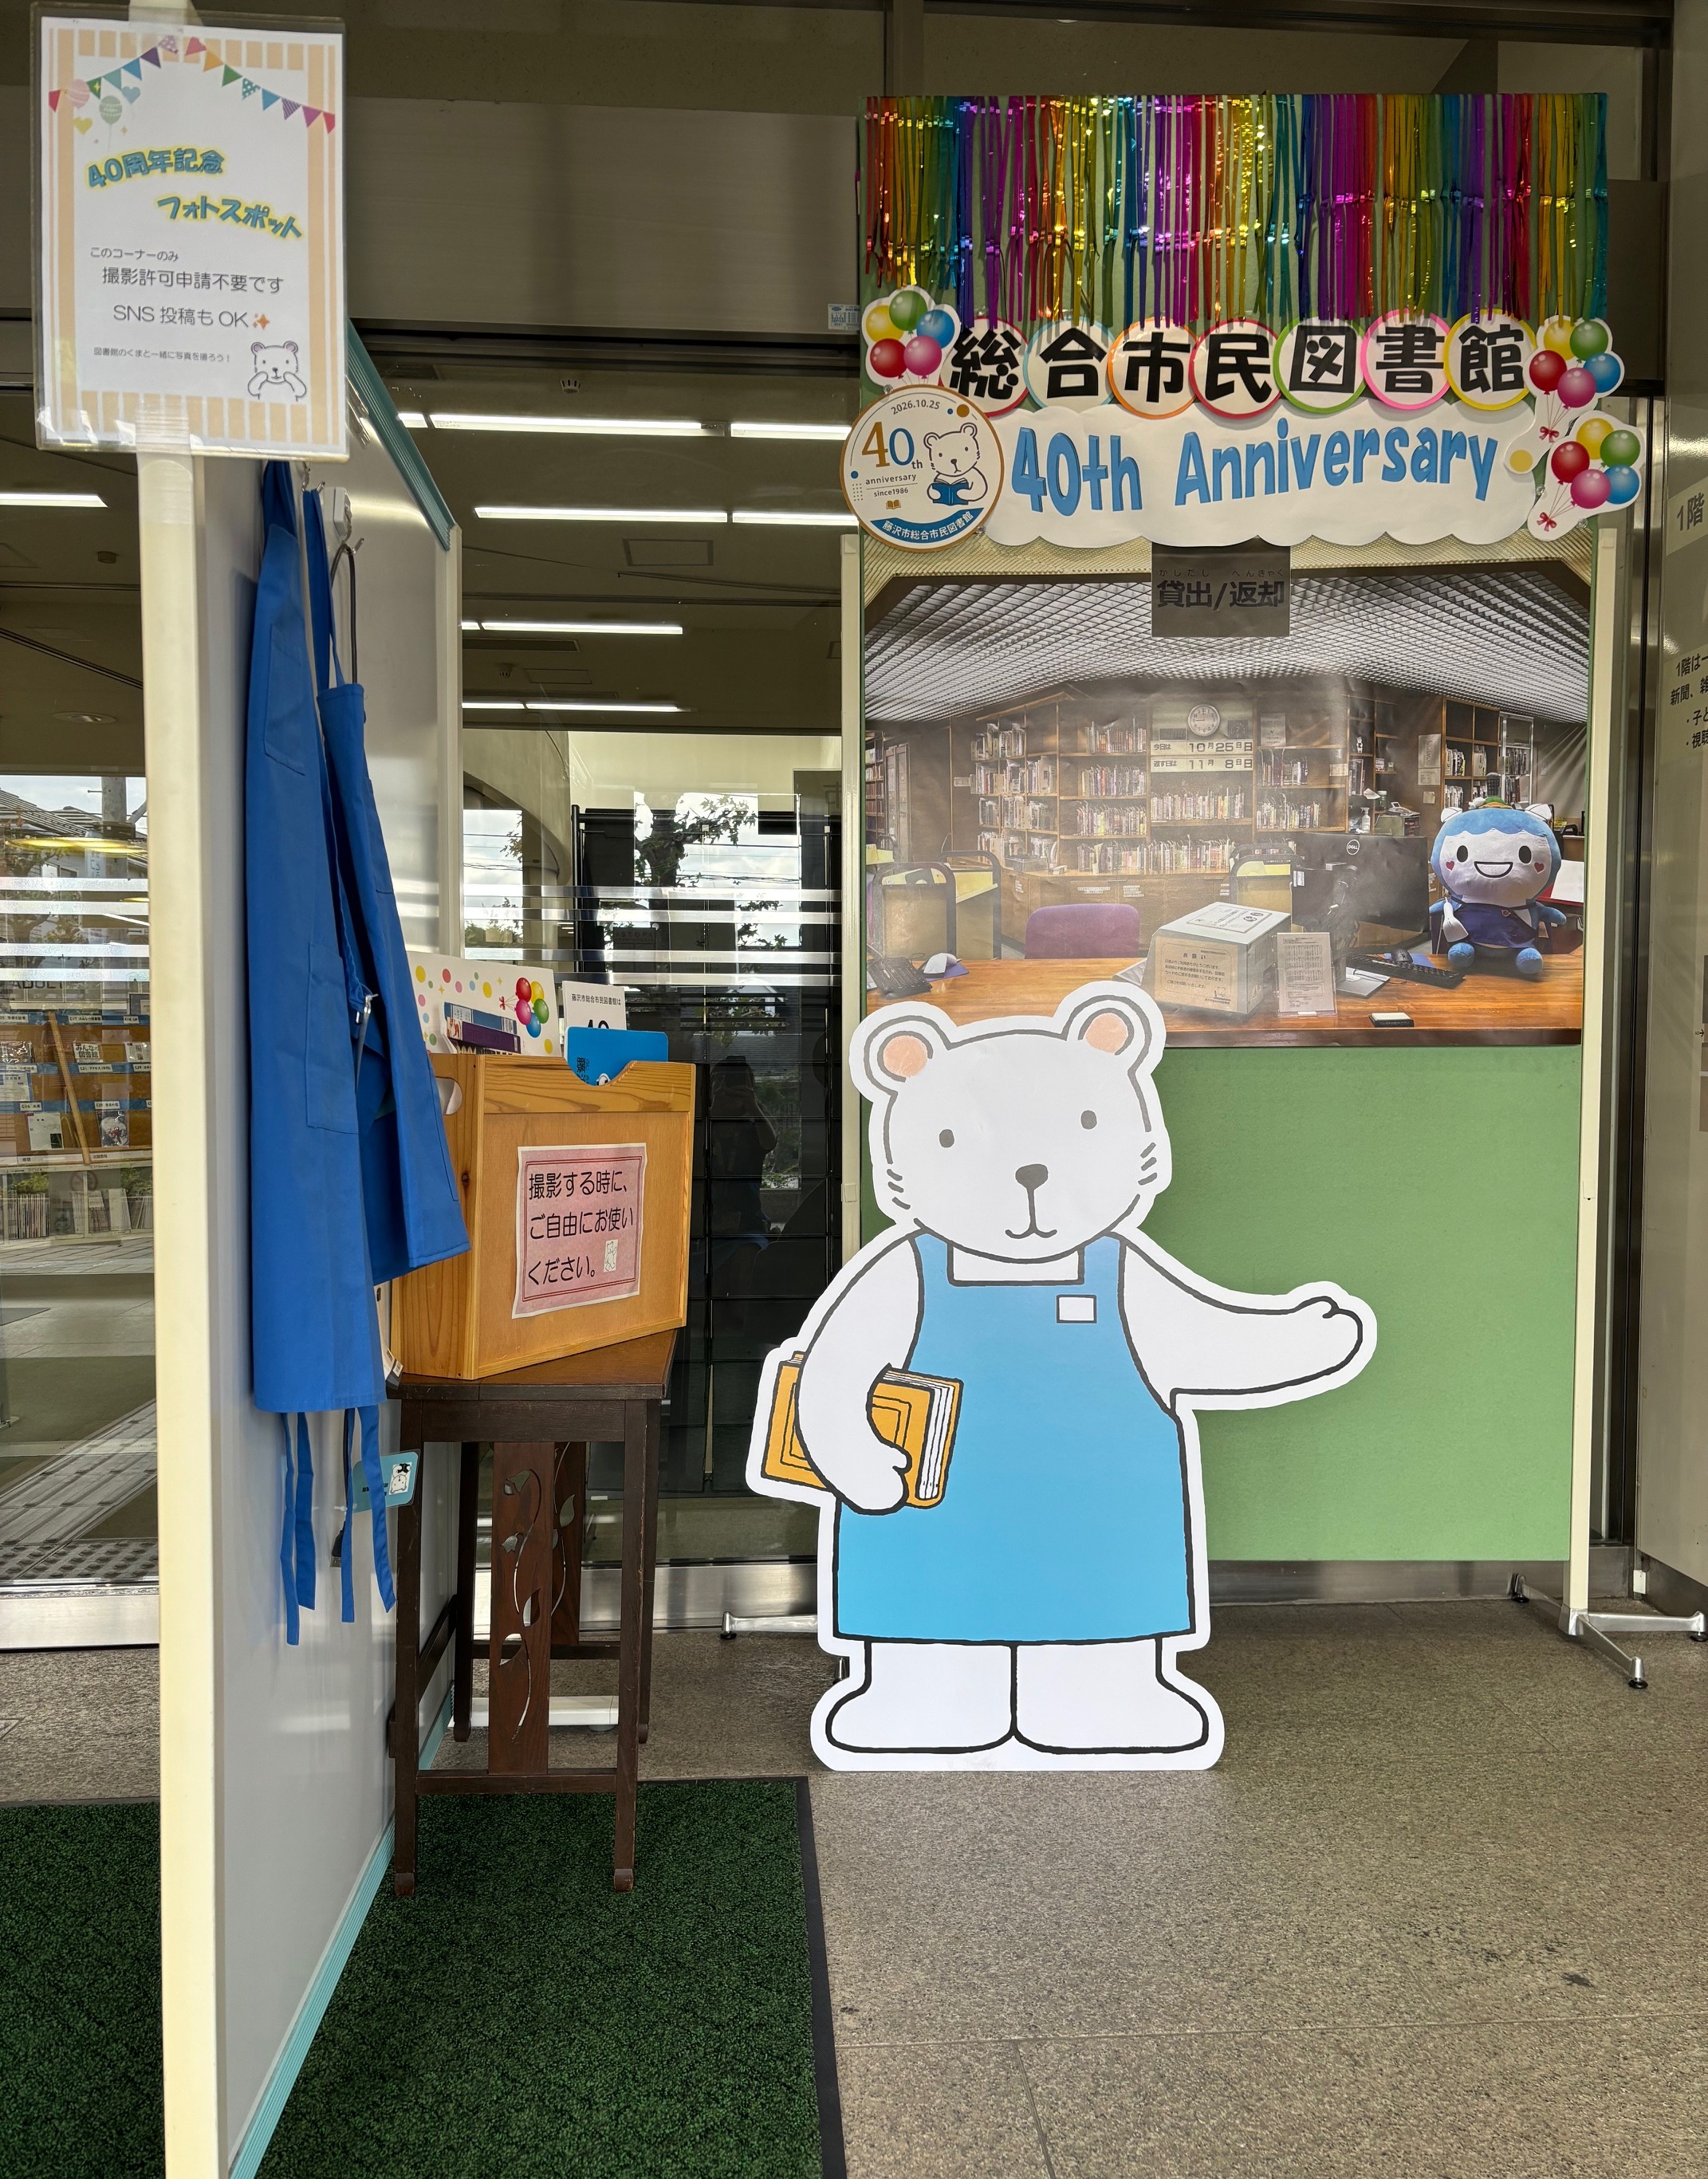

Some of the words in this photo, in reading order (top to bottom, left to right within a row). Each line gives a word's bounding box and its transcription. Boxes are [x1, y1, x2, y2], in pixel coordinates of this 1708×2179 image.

[88, 147, 226, 188] 40周年記念
[157, 195, 302, 239] フォトスポット
[90, 247, 179, 262] このコーナーのみ
[102, 266, 285, 293] 撮影許可申請不要です
[113, 305, 155, 322] SNS
[159, 305, 214, 326] 投稿も
[218, 311, 250, 328] OK
[950, 325, 1525, 403] 総合市民図書館
[891, 399, 940, 415] 2026.10.25
[865, 474, 917, 486] anniversary
[1011, 427, 1142, 517] 40th
[1175, 417, 1498, 507] Anniversary
[874, 487, 909, 498] since1986
[881, 510, 974, 541] 藤沢市総合市民図書館
[1676, 492, 1706, 532] 1階
[1157, 580, 1285, 611] 貸出/返却
[571, 993, 622, 1005] 藤沢市総合市民図書館は
[529, 1170, 628, 1200] 撮影する時に、
[530, 1207, 633, 1240] ご自由にお使い
[528, 1256, 595, 1285] ください。
